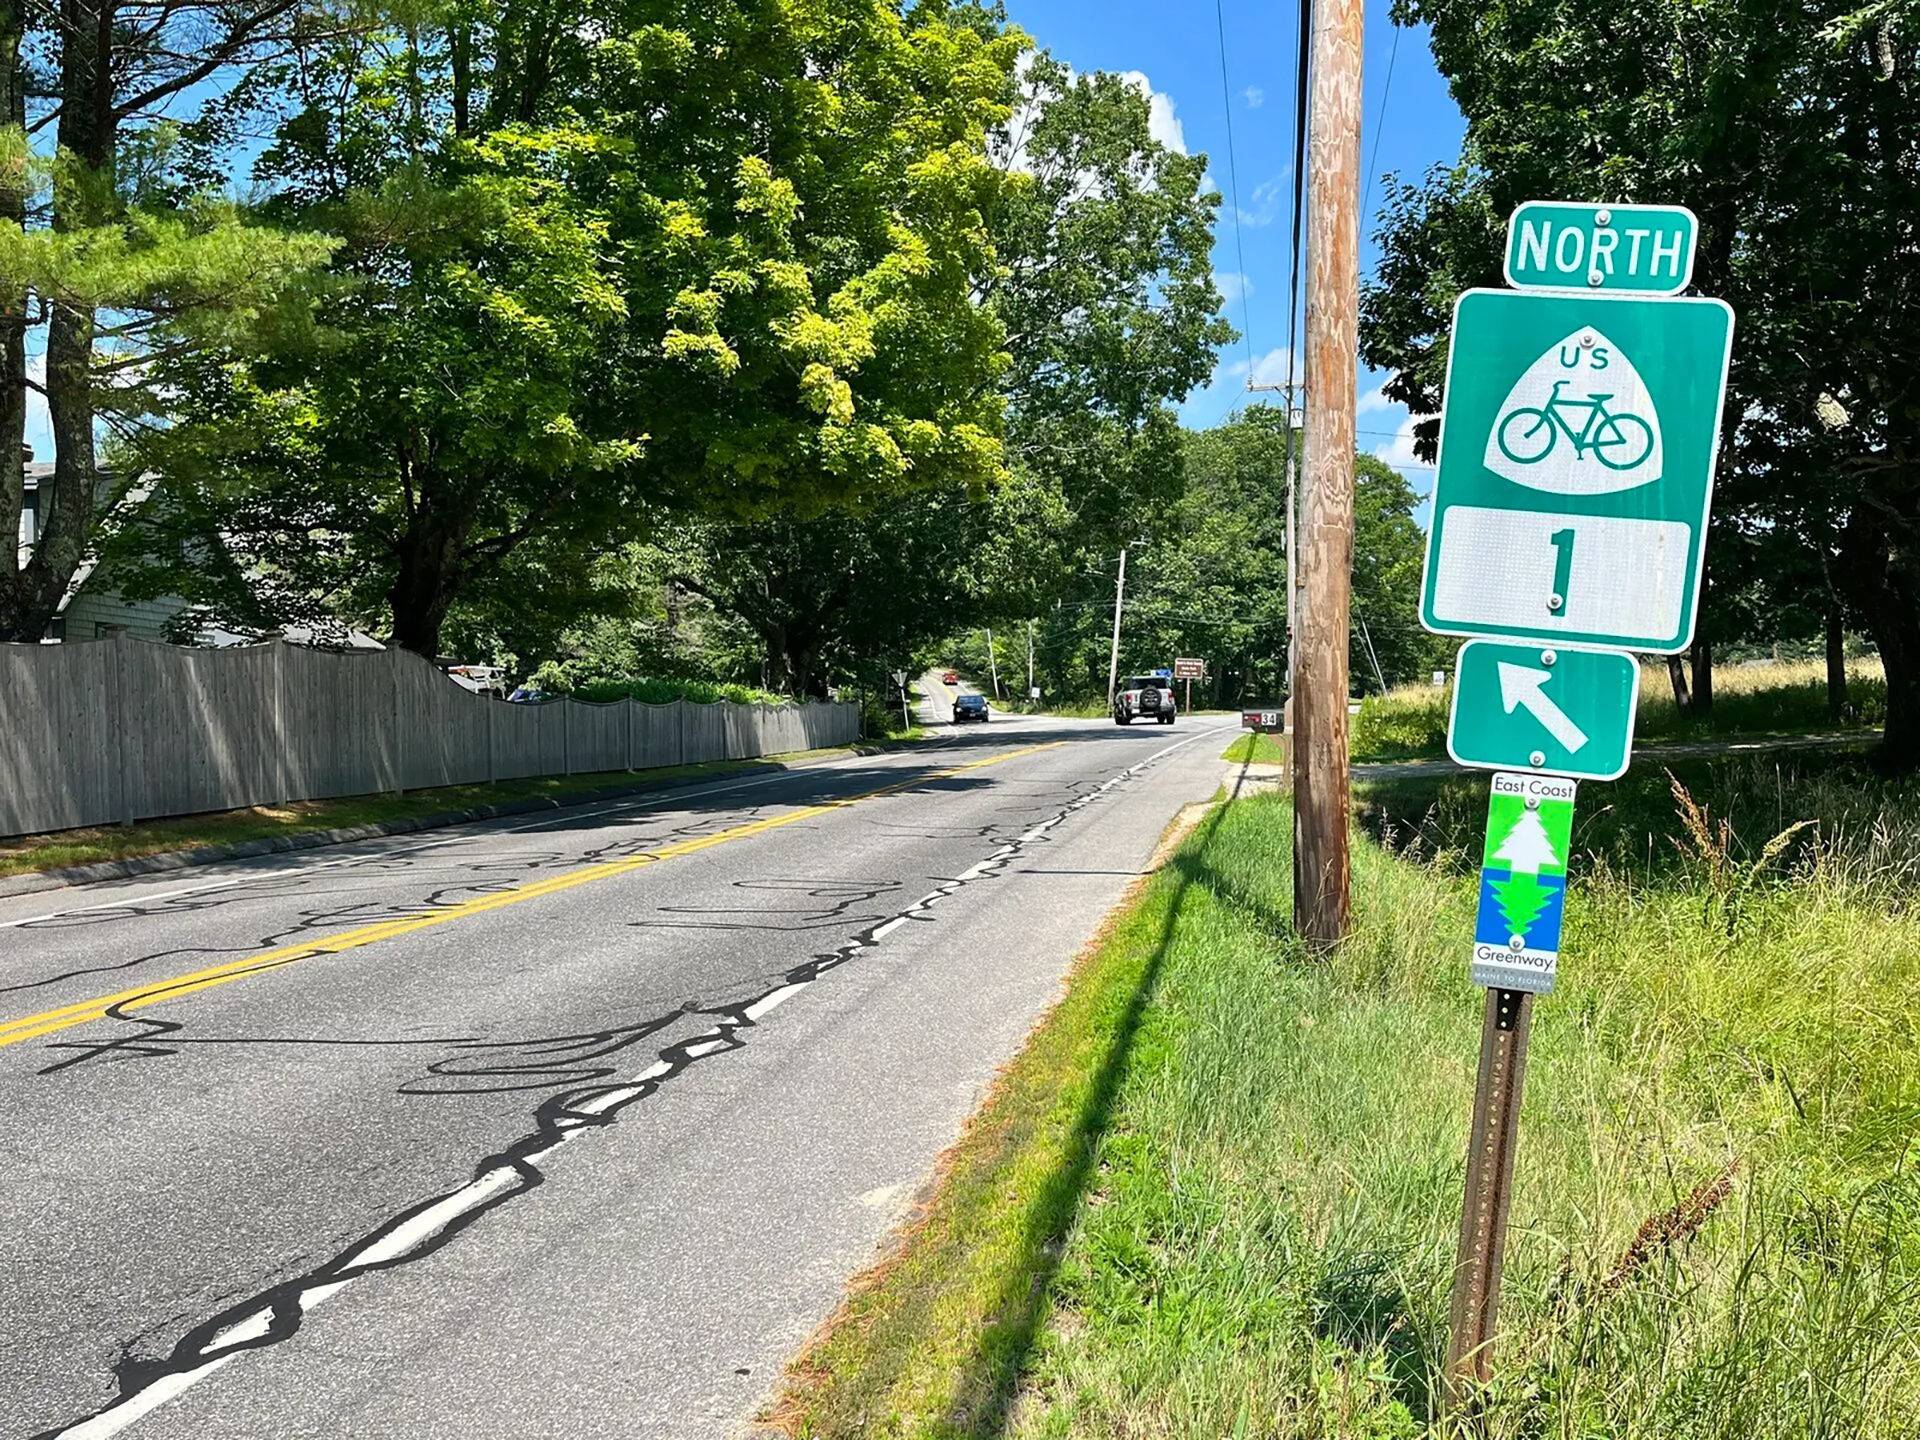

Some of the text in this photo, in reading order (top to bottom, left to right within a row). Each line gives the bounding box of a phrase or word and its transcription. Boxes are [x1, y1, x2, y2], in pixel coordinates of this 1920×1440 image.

[1516, 220, 1683, 277] NORTH
[1560, 346, 1609, 370] US
[1550, 529, 1576, 618] 1
[1262, 714, 1275, 725] 34
[1495, 777, 1573, 798] East Coast
[1477, 946, 1553, 972] Greenway
[1475, 971, 1500, 981] MAINE
[1518, 977, 1551, 987] FLORIDA
